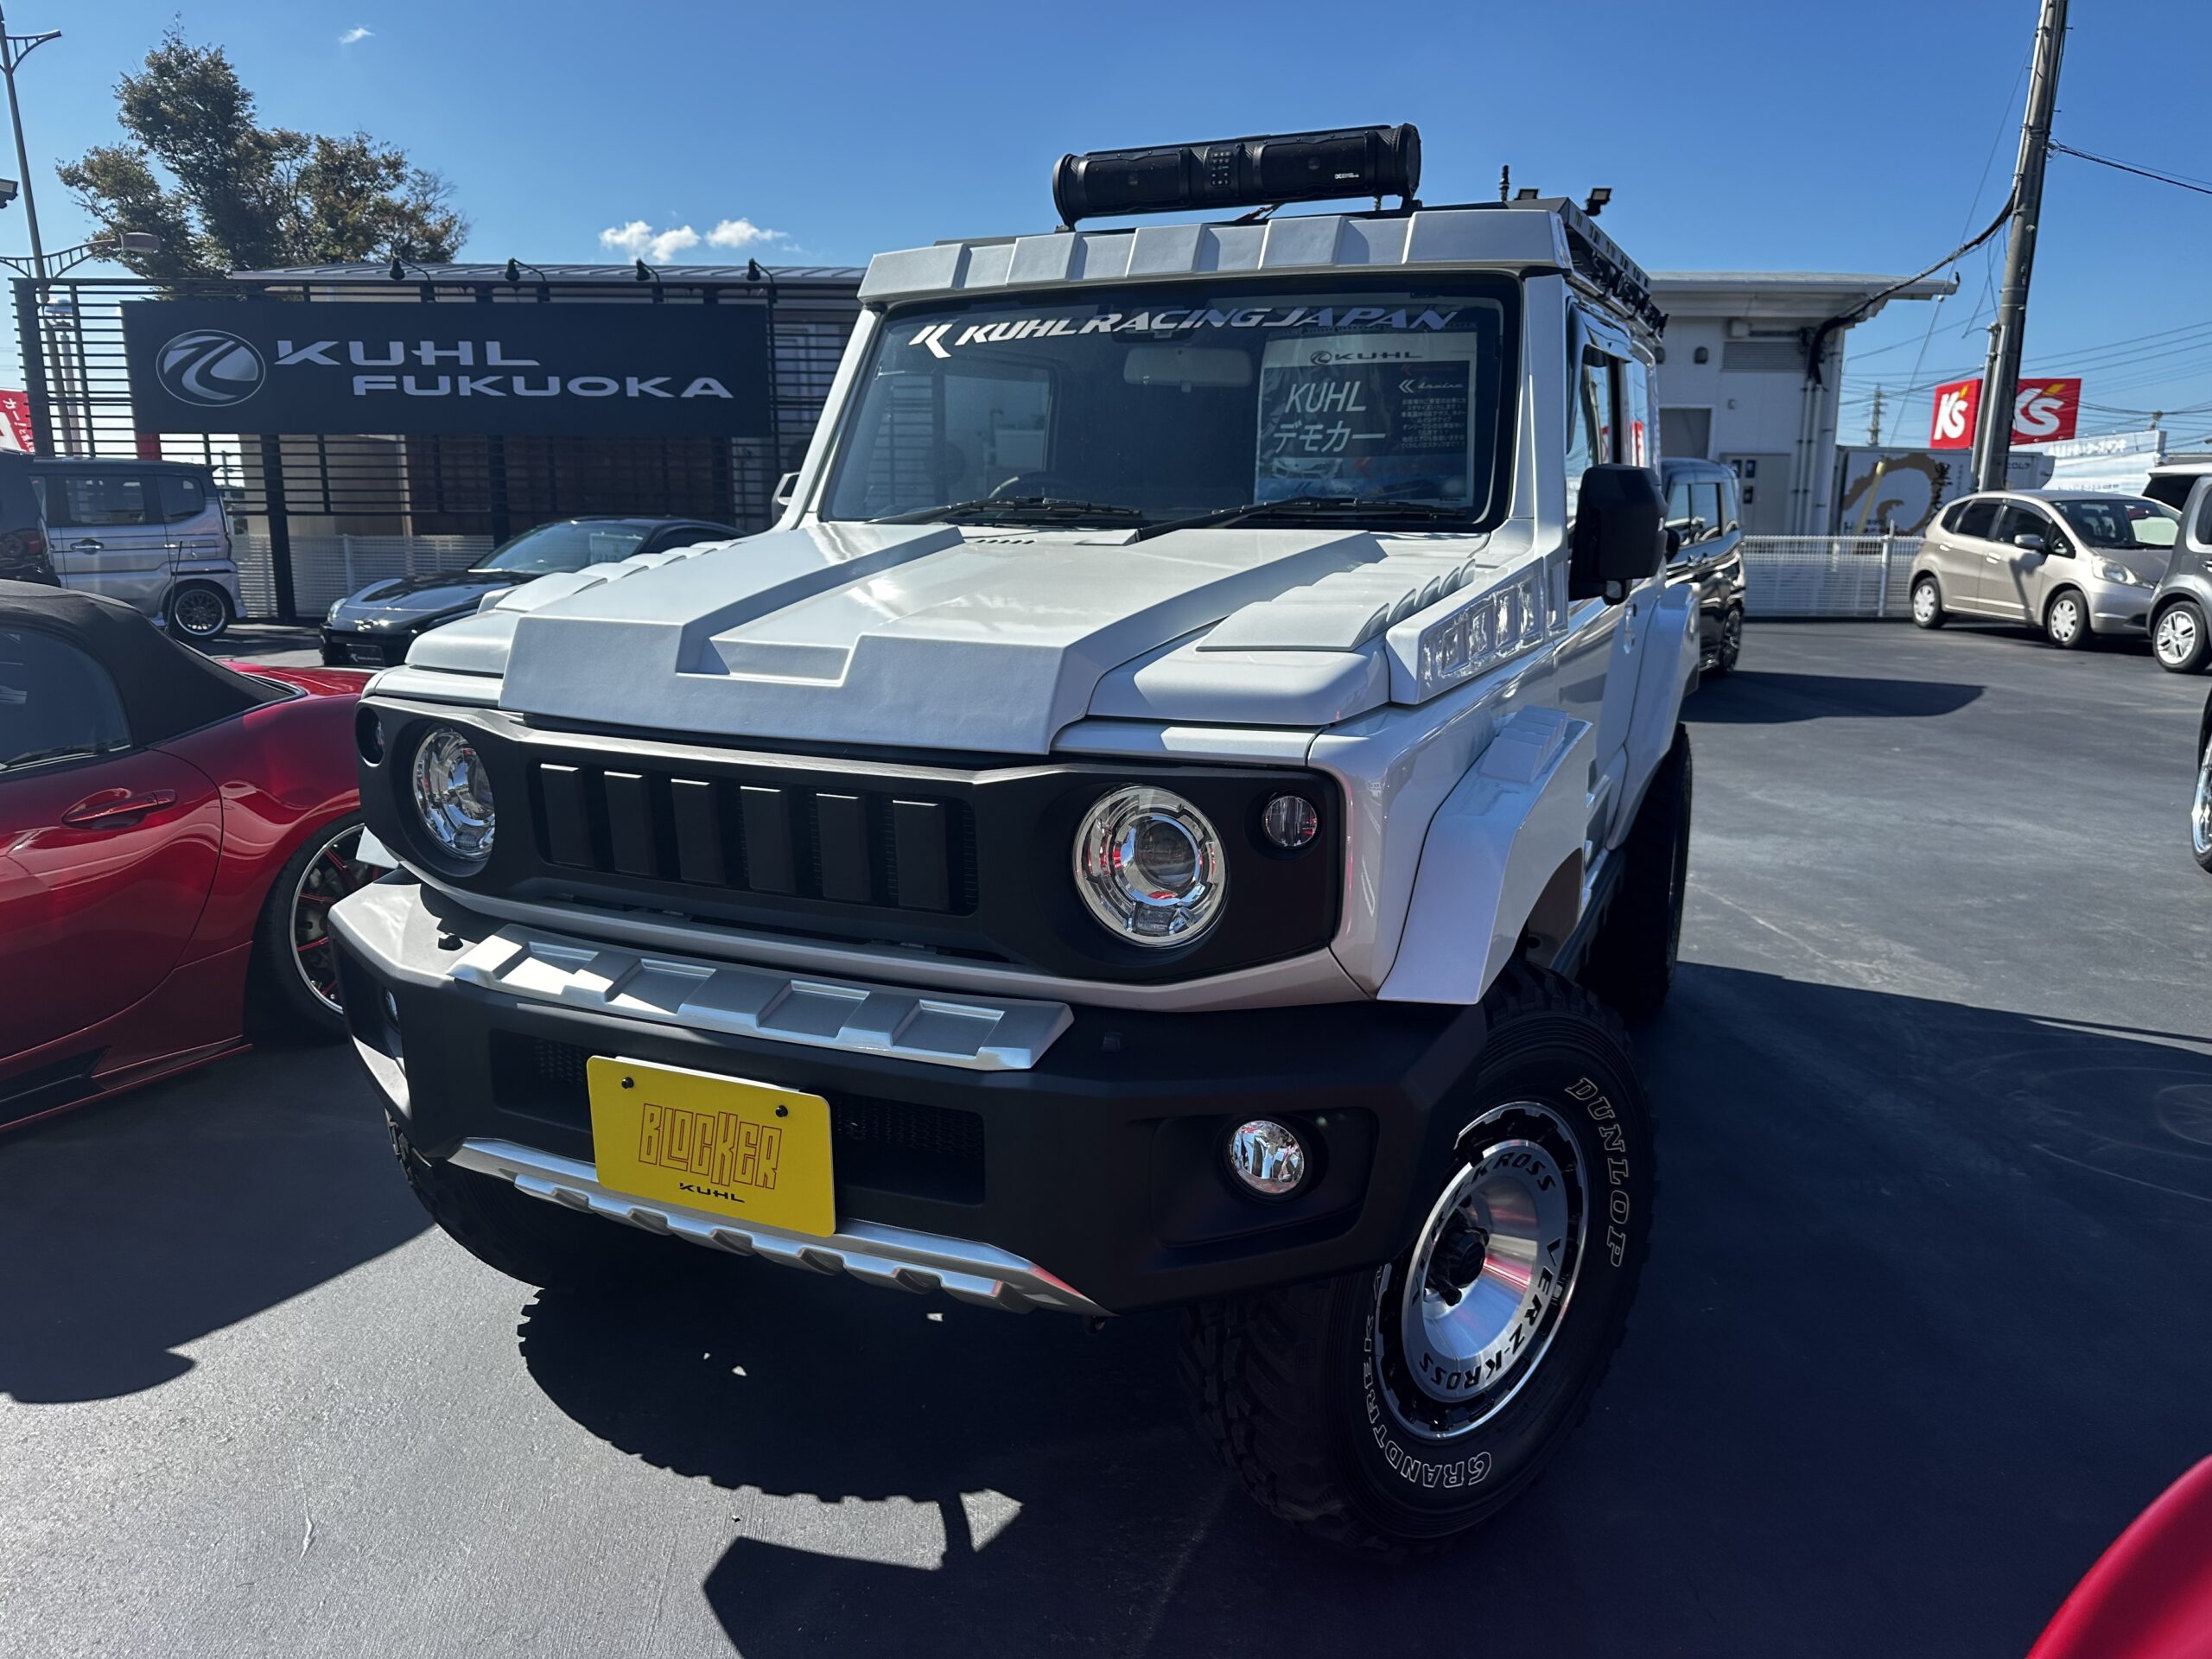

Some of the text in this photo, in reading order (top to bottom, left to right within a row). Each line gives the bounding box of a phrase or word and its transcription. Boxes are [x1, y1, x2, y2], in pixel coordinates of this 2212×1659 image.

[274, 340, 540, 366] KUHL
[1336, 351, 1422, 361] KUHL
[353, 375, 734, 399] FUKUOKA
[1285, 380, 1367, 414] KUHL
[1274, 420, 1386, 454] デモカー
[639, 1103, 782, 1190] BLOCKER
[1564, 1077, 1630, 1268] DUNLOP
[678, 1182, 746, 1204] KUHL
[1419, 1237, 1562, 1390] VERZ-KROSS
